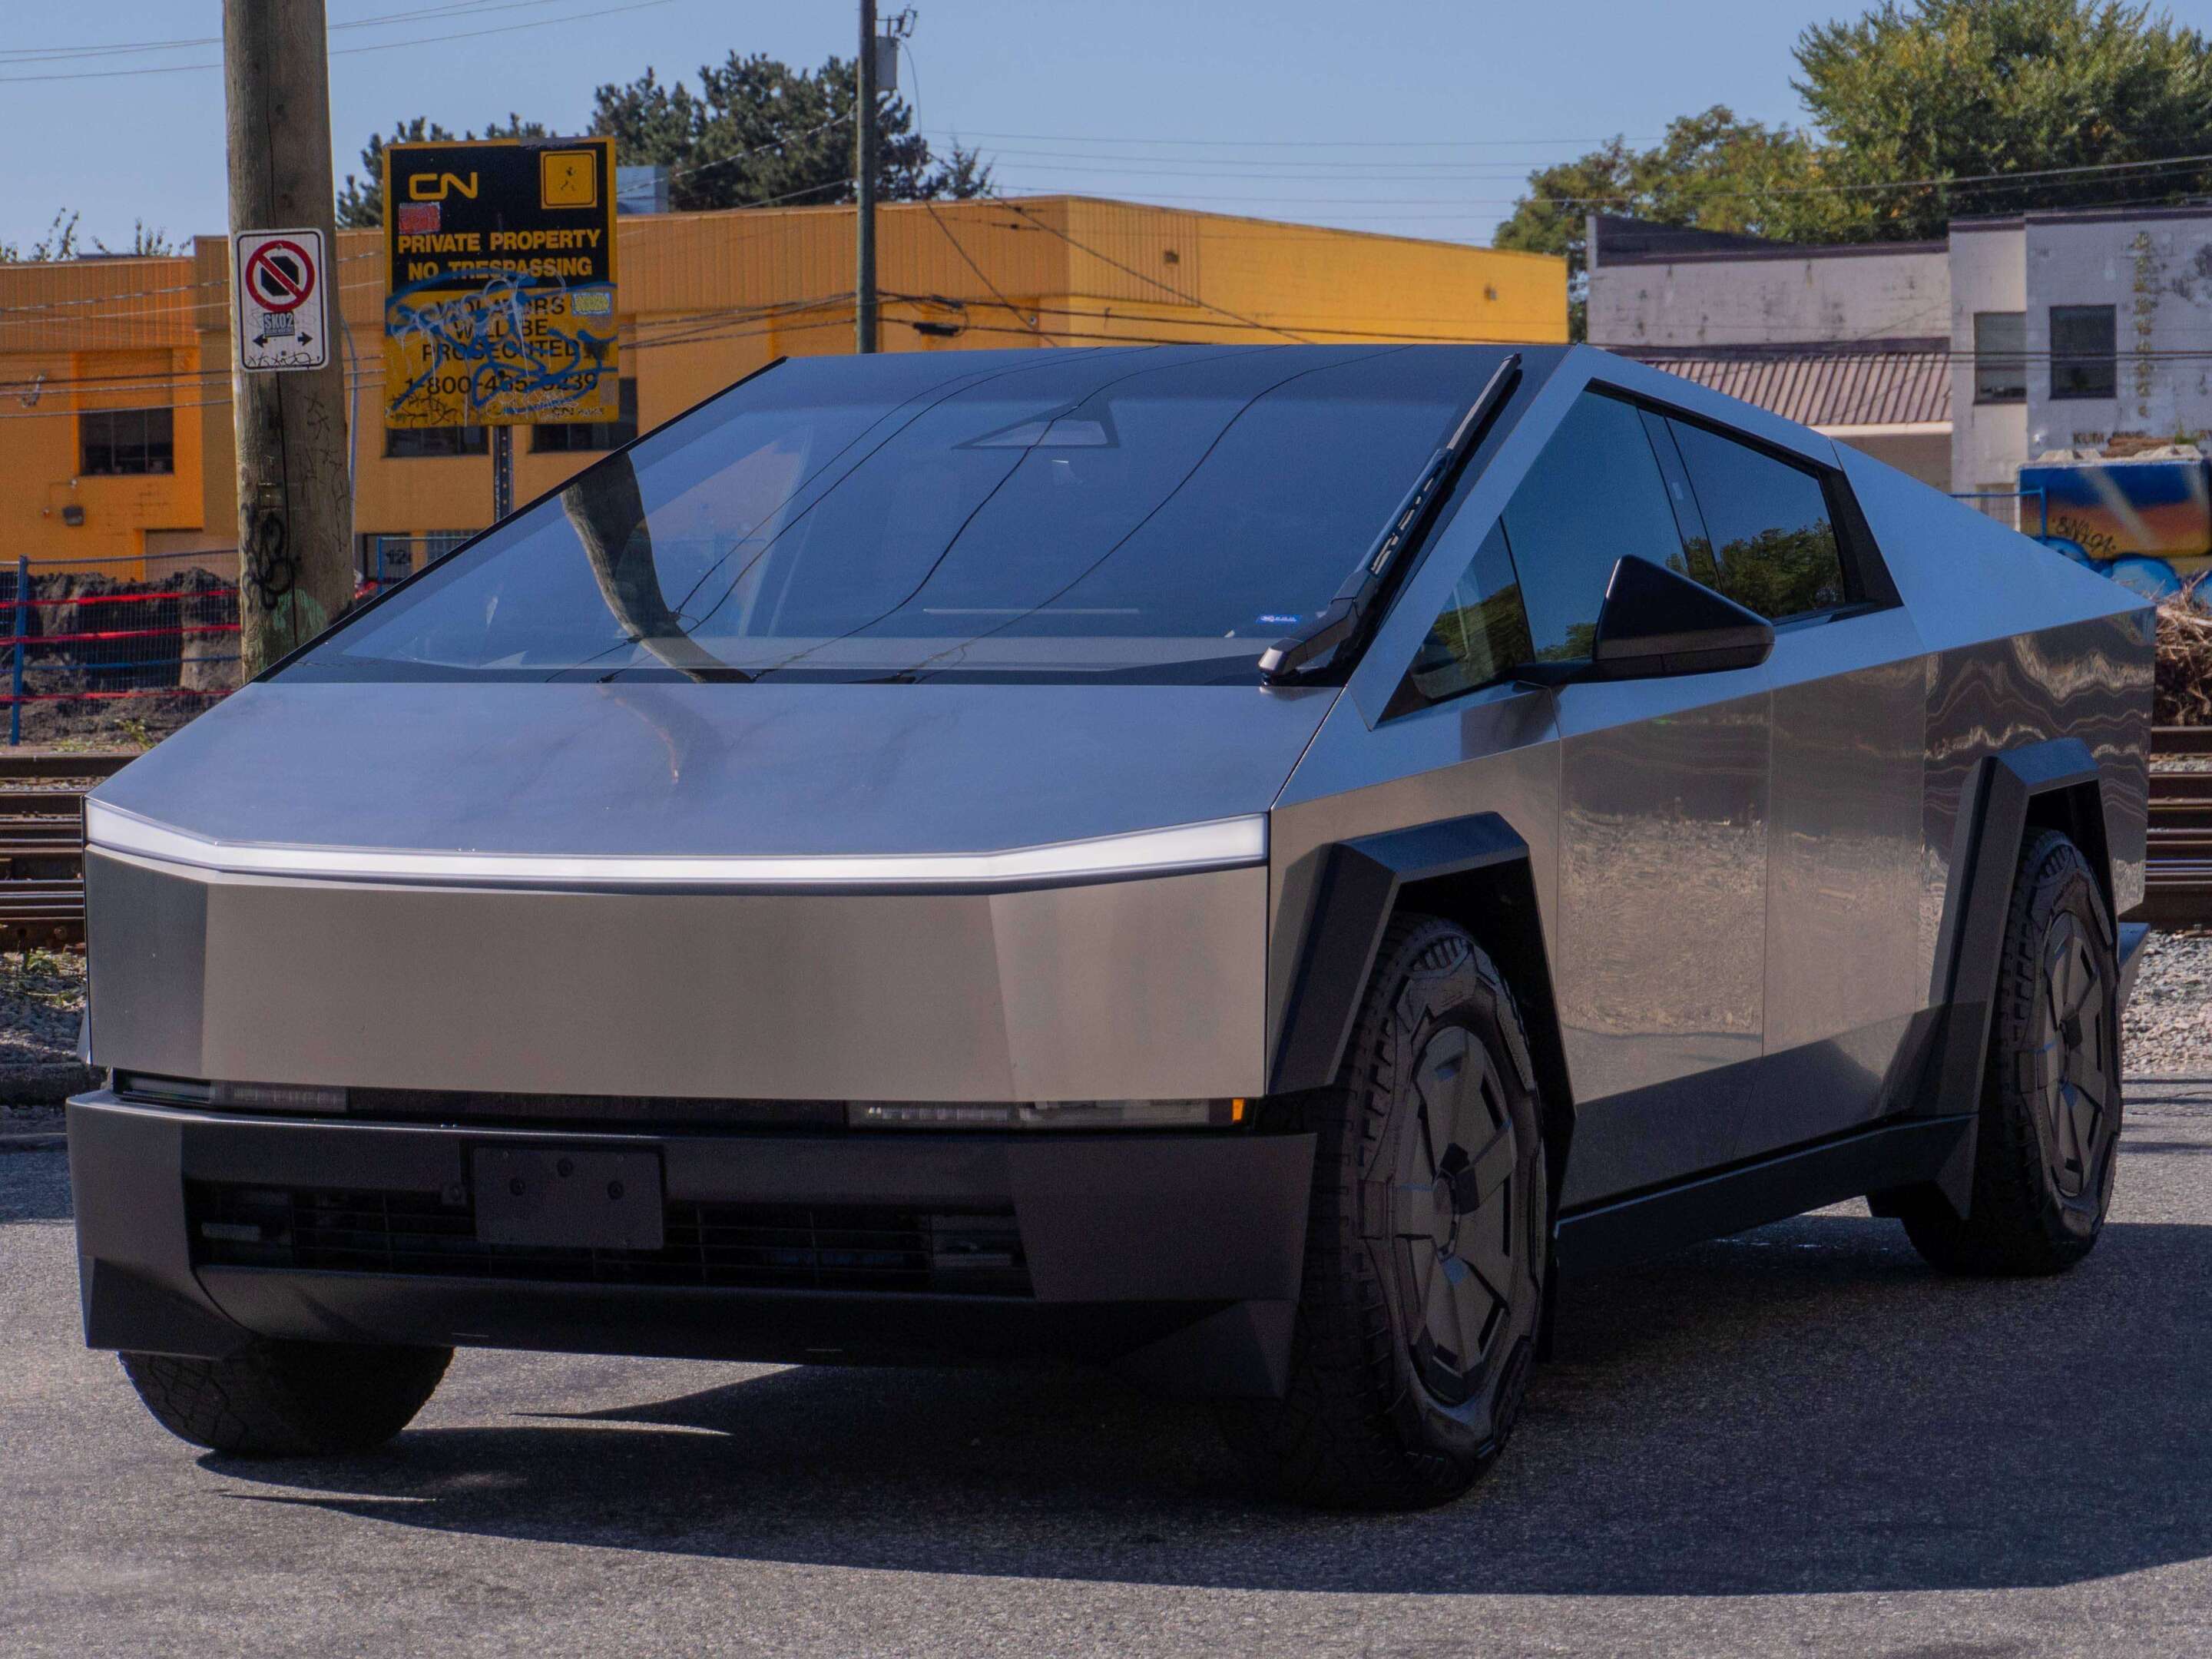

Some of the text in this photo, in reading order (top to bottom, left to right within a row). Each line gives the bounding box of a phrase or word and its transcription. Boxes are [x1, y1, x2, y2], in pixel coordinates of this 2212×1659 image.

[409, 171, 478, 200] CN
[398, 229, 601, 253] PRIVATE PROPERTY
[408, 257, 593, 281] NO TRESPASSING
[522, 319, 548, 336] BE
